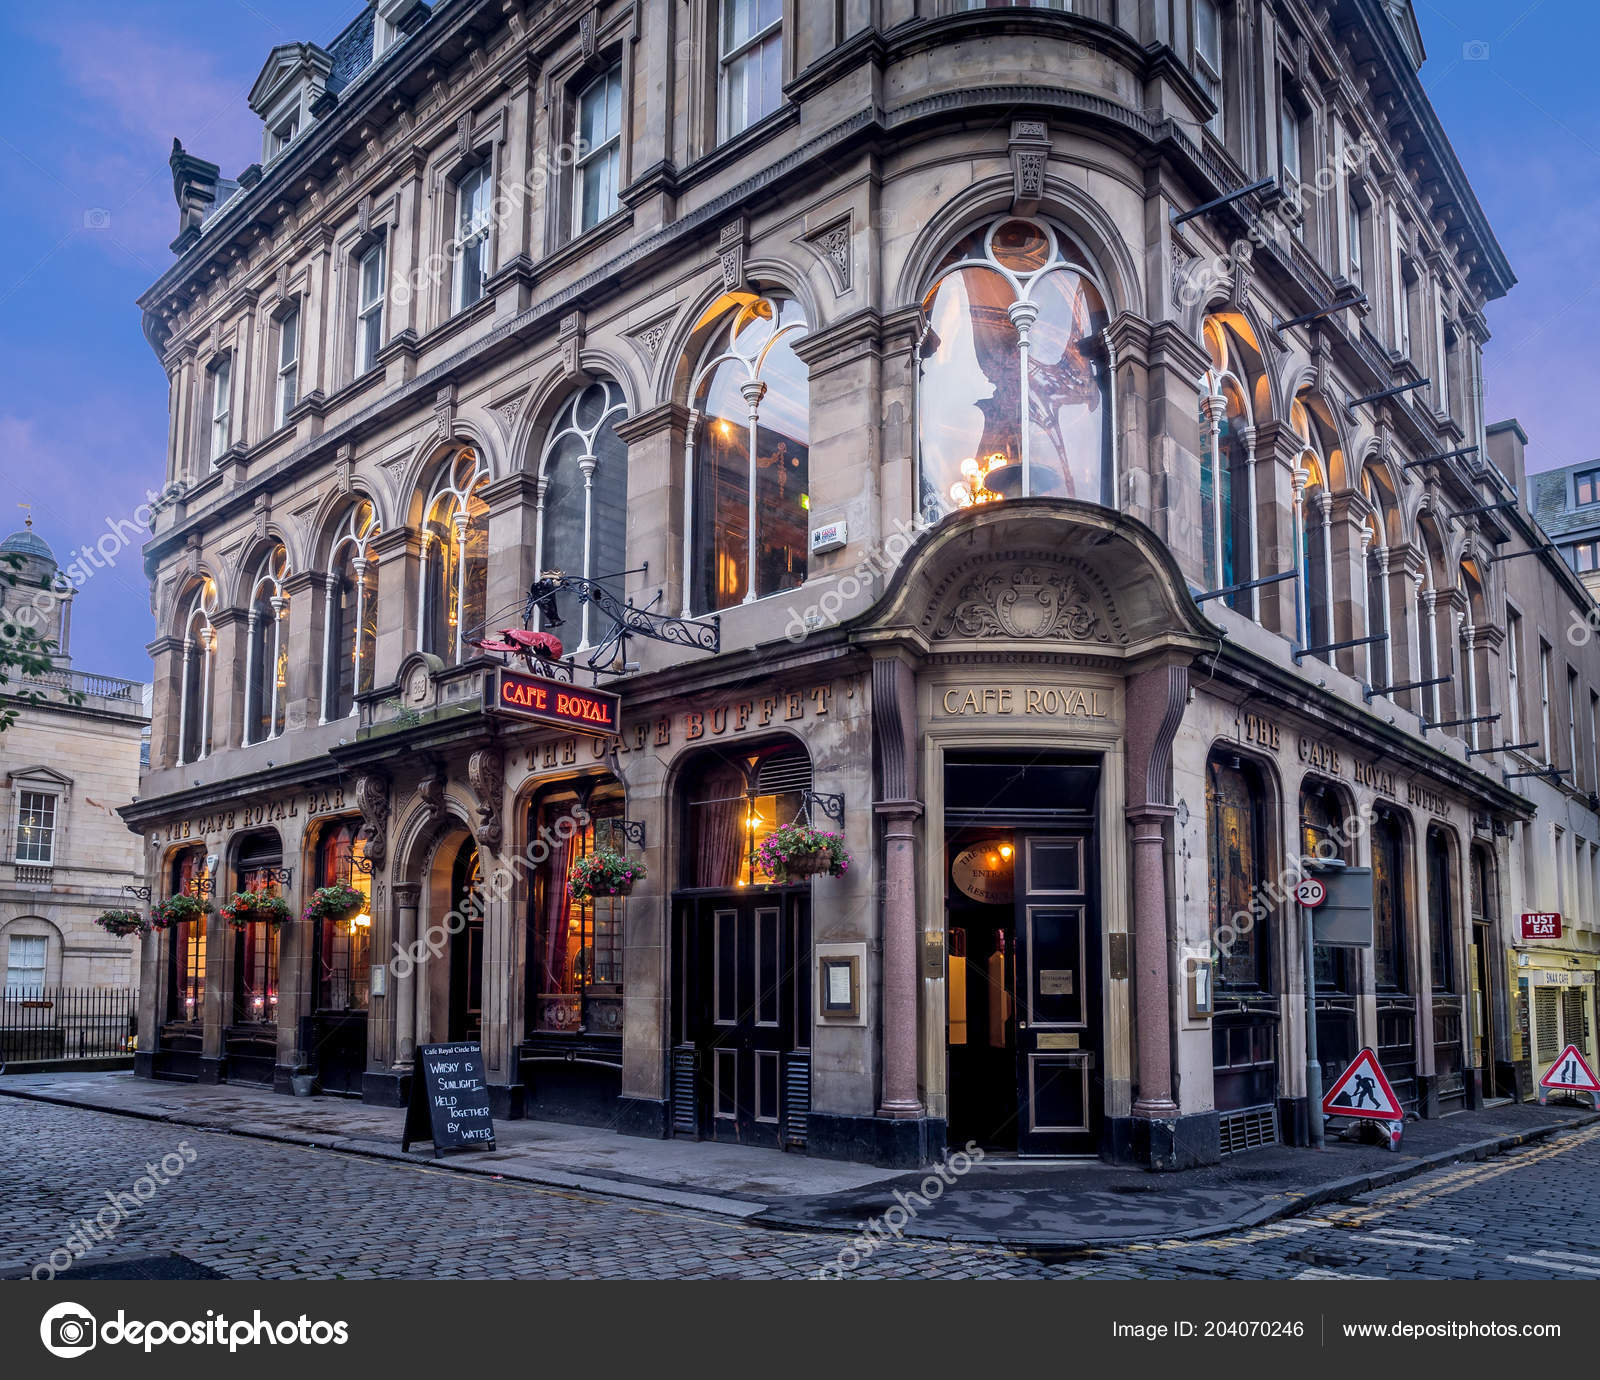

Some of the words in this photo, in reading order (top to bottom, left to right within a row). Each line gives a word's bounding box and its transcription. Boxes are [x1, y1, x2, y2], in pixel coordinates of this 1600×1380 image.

[503, 681, 547, 709] CAFE
[556, 693, 611, 724] ROYAL
[943, 689, 1013, 714] CAFE
[1025, 689, 1107, 717] ROYAL
[525, 739, 576, 771] THE
[686, 686, 832, 740] BUFFET
[1245, 713, 1280, 750] THE
[1298, 737, 1341, 774] CAFE
[1354, 760, 1397, 796] ROYAL
[165, 821, 191, 841] THE
[199, 811, 234, 834] CAFE
[243, 798, 297, 826] ROYAL
[307, 788, 345, 814] BAR
[960, 849, 977, 865] THE
[1300, 886, 1321, 899] 20
[1525, 915, 1555, 924] JUST
[1533, 925, 1555, 934] EAT
[438, 1047, 453, 1055] Royal
[430, 1062, 459, 1074] WHISKY
[465, 1062, 473, 1072] IS
[438, 1077, 479, 1090] SUNLIGHT
[435, 1096, 457, 1107] HELD
[447, 1106, 489, 1118] TOGETHER
[447, 1122, 460, 1133] BY
[461, 1128, 491, 1139] WATER
